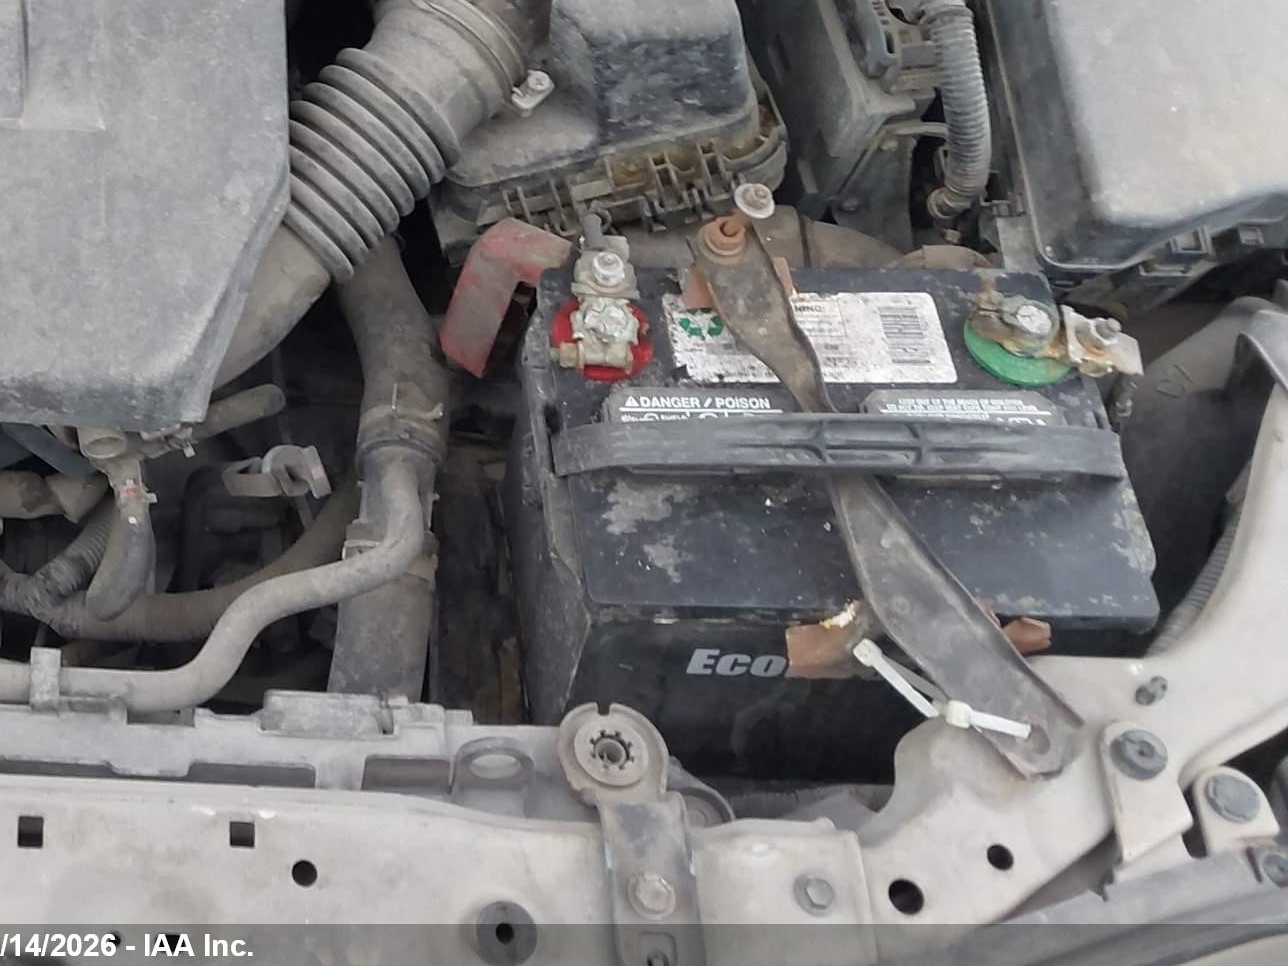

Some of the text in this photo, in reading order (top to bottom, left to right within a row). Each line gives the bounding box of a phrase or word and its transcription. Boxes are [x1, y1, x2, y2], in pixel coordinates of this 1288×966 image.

[639, 395, 771, 409] DANGER / POISON
